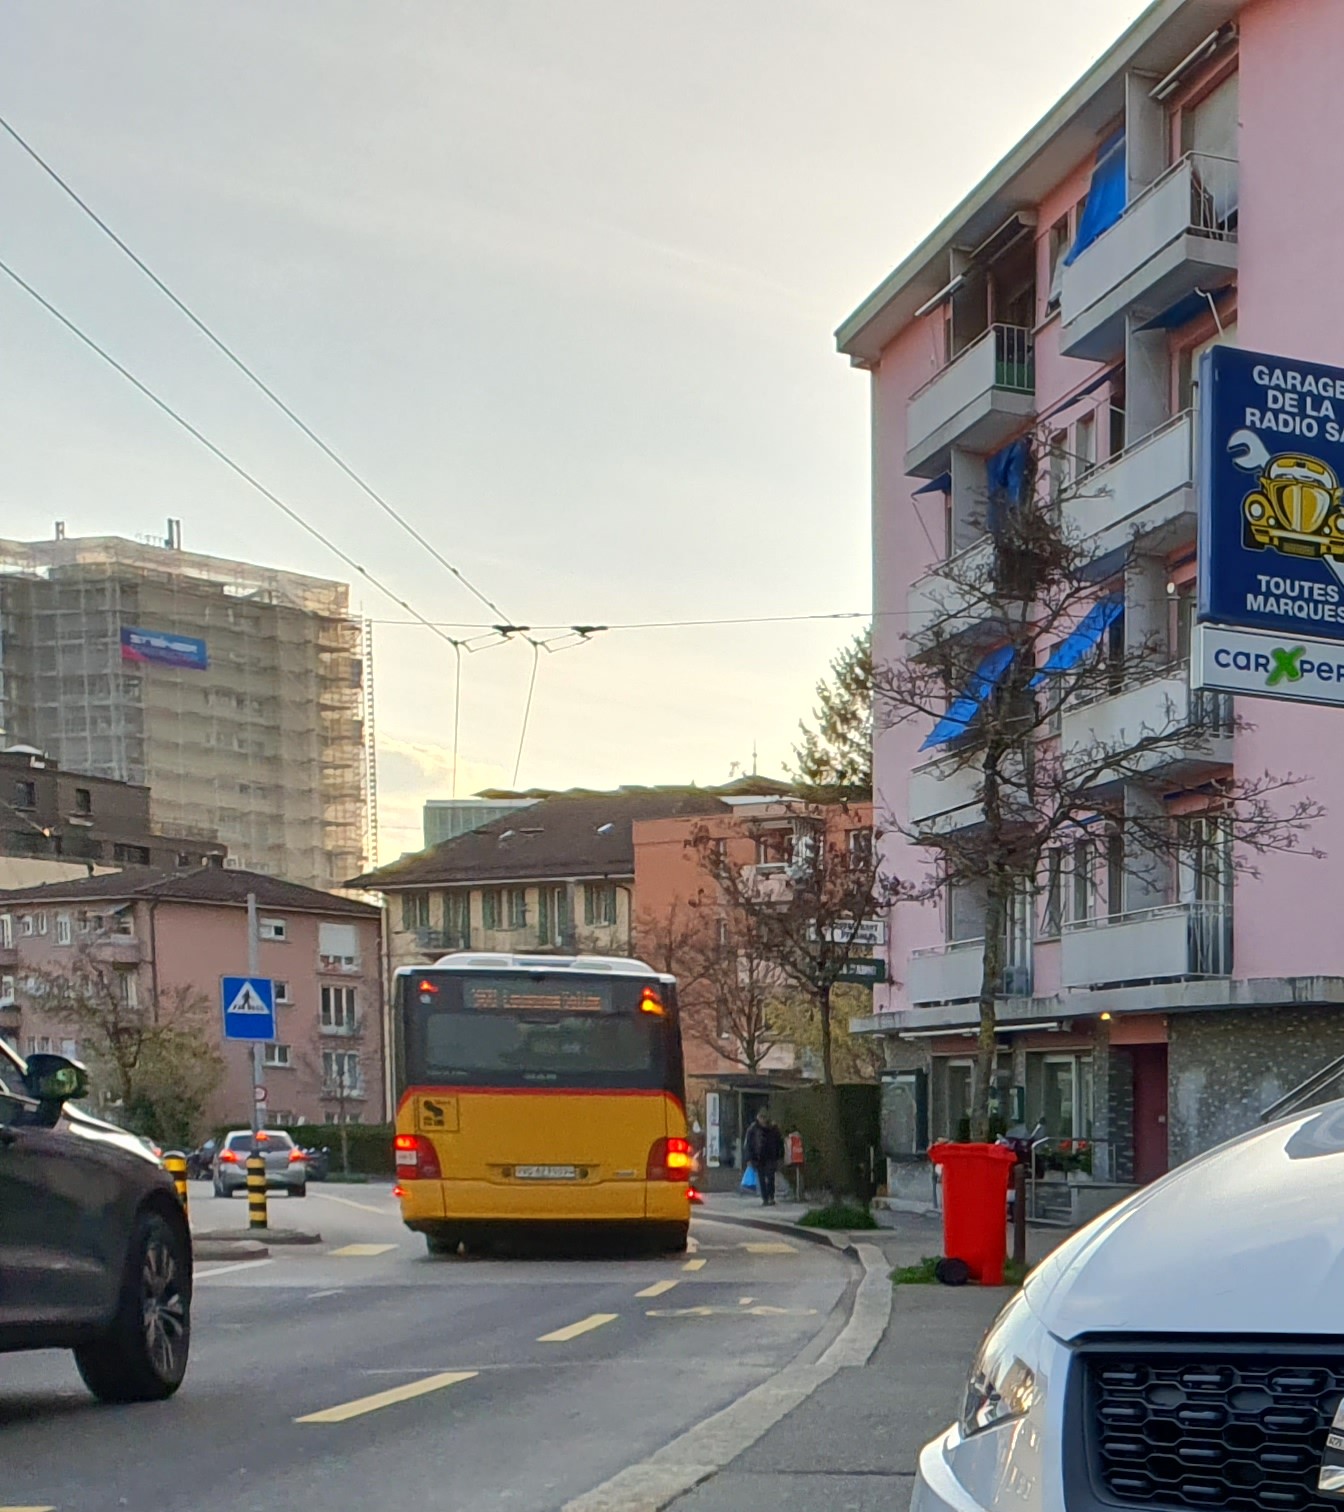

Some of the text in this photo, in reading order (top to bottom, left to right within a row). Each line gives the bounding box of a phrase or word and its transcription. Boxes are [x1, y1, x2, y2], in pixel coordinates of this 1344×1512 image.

[1266, 390, 1336, 420] DE LA
[1245, 408, 1319, 439] RADIO
[1257, 575, 1340, 603] TOUTES
